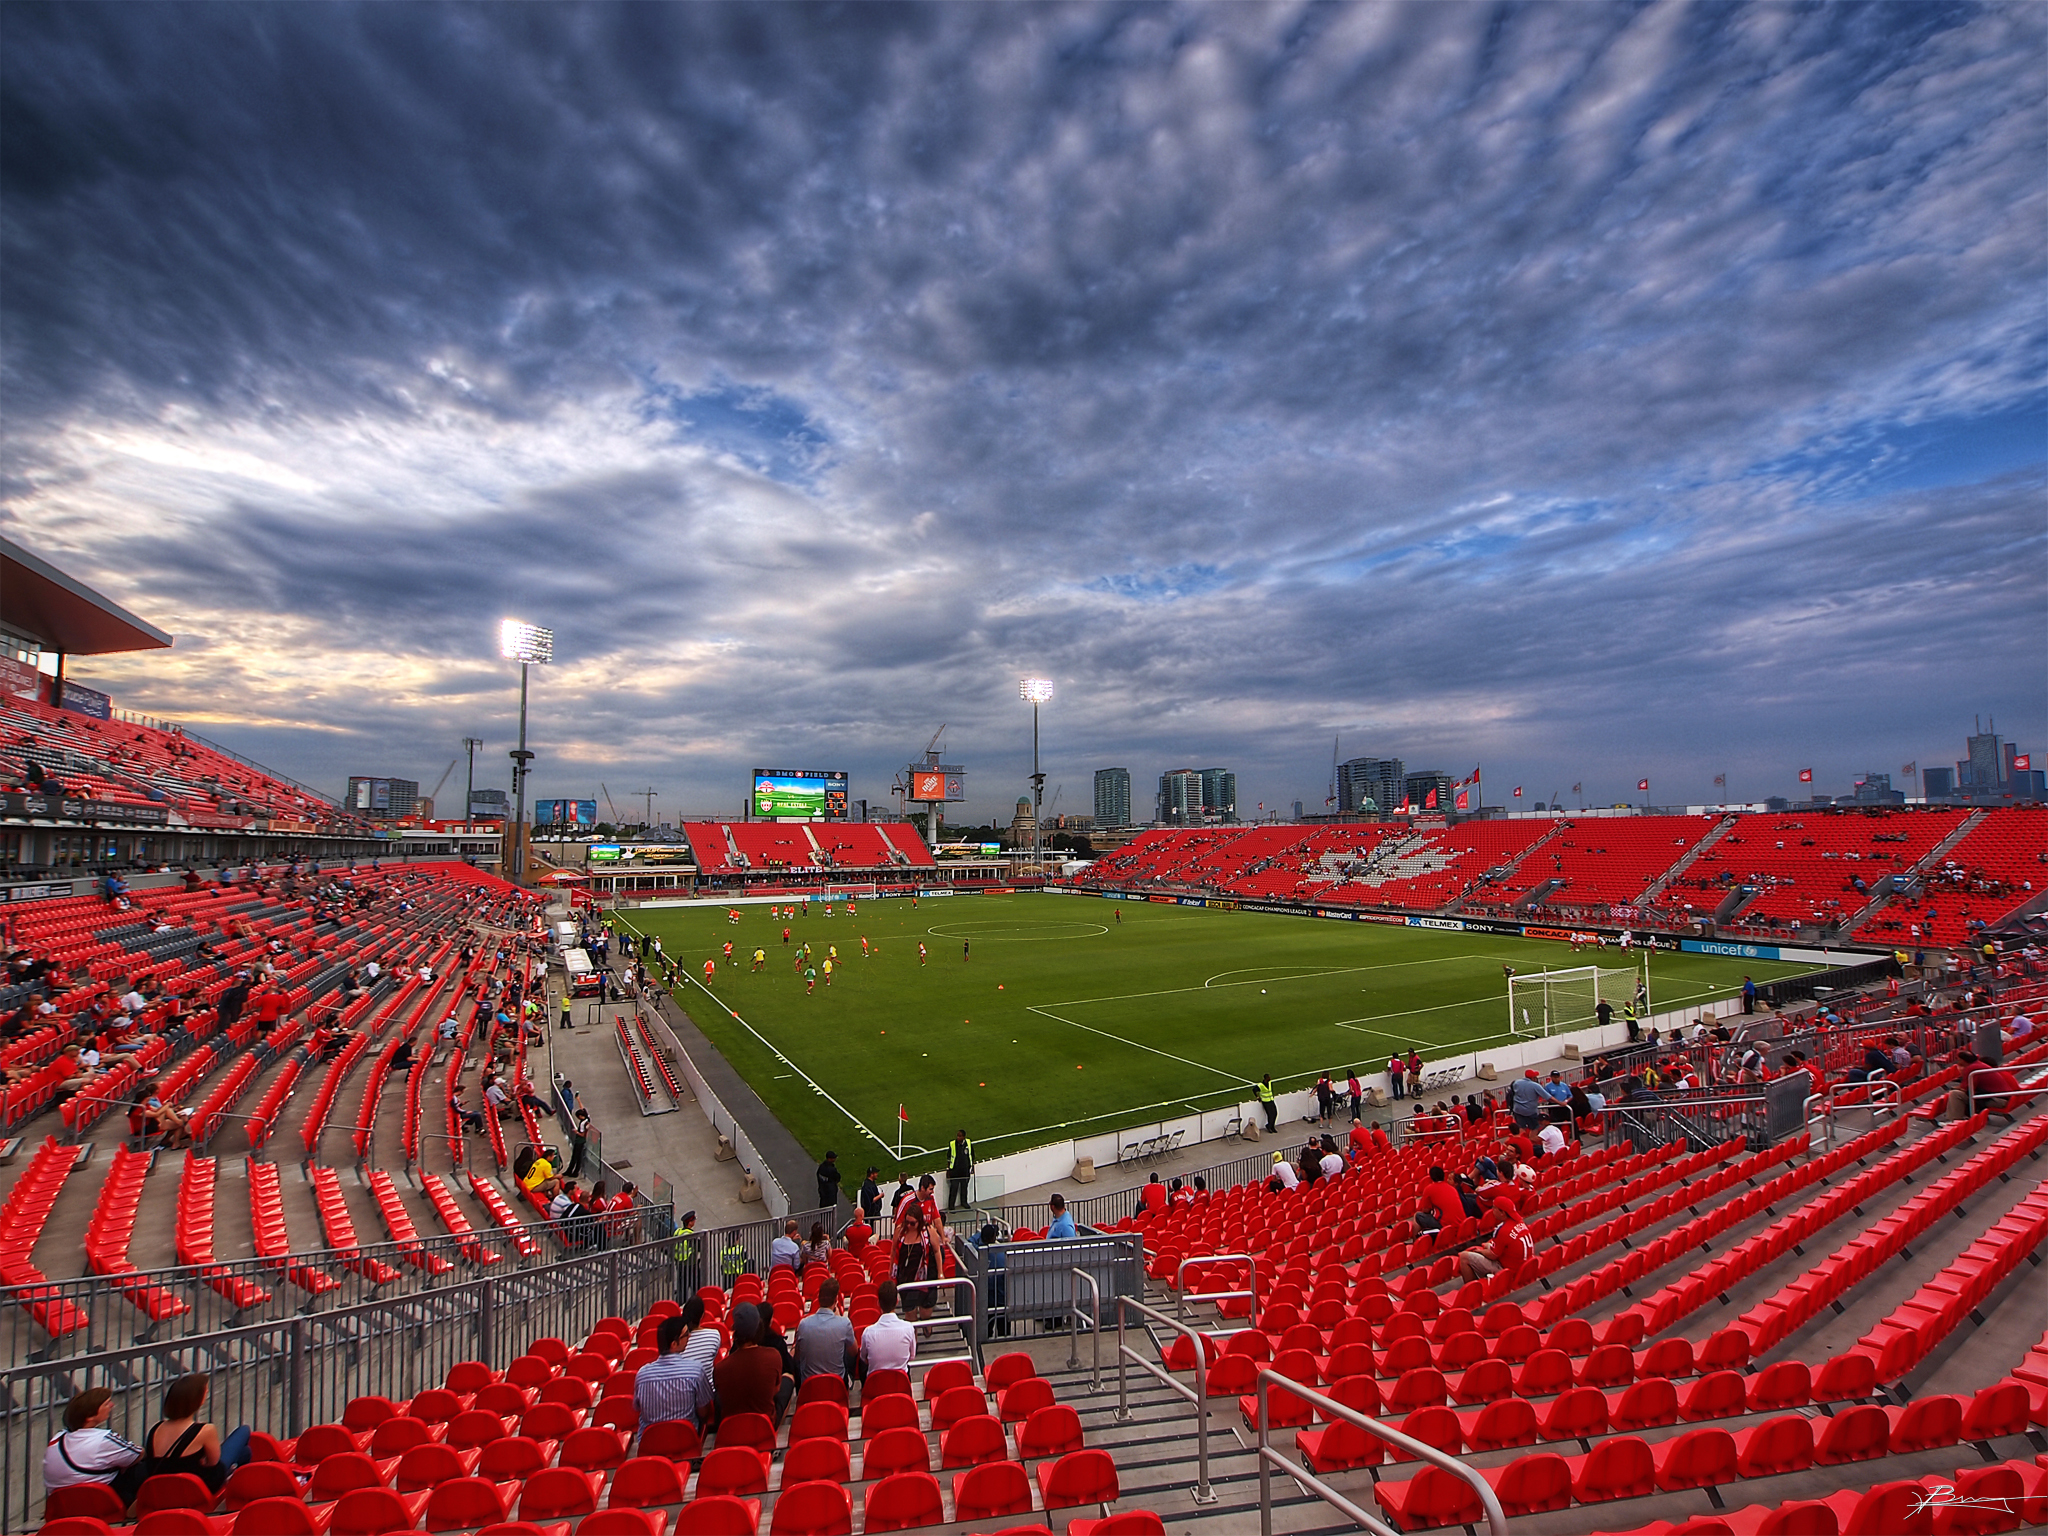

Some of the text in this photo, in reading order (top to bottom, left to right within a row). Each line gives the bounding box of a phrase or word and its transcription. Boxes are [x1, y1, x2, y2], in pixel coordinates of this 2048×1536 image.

[790, 866, 823, 874] ELITE
[1264, 906, 1290, 914] CHAMPIONS
[1325, 910, 1353, 920] MasterCard
[1423, 919, 1460, 929] TELMEX
[1465, 923, 1494, 932] SONY
[1700, 943, 1742, 956] unicef
